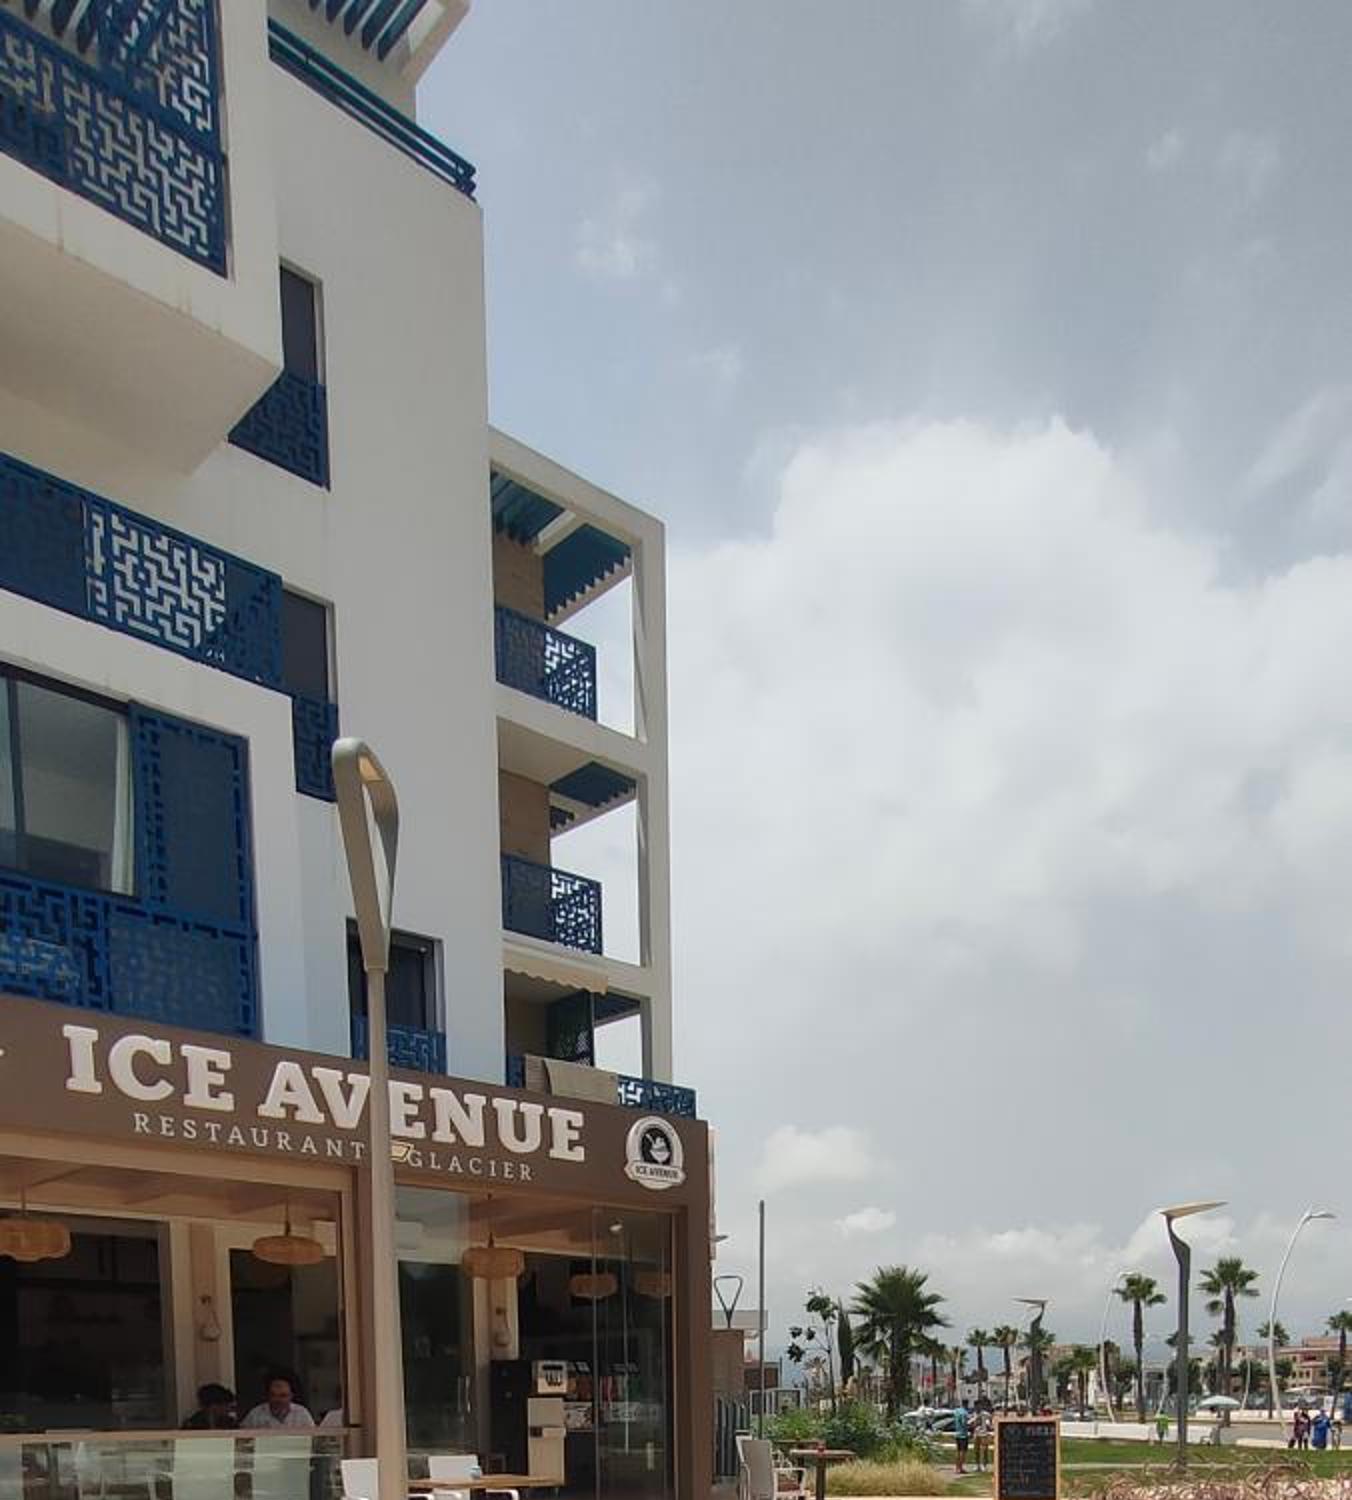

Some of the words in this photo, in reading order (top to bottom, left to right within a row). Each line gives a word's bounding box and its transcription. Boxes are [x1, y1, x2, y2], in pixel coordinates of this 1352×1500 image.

[63, 1025, 234, 1112] ICE
[258, 1061, 586, 1160] AVENUE
[134, 1113, 366, 1160] RESTAURANT
[408, 1149, 534, 1181] GLACIER
